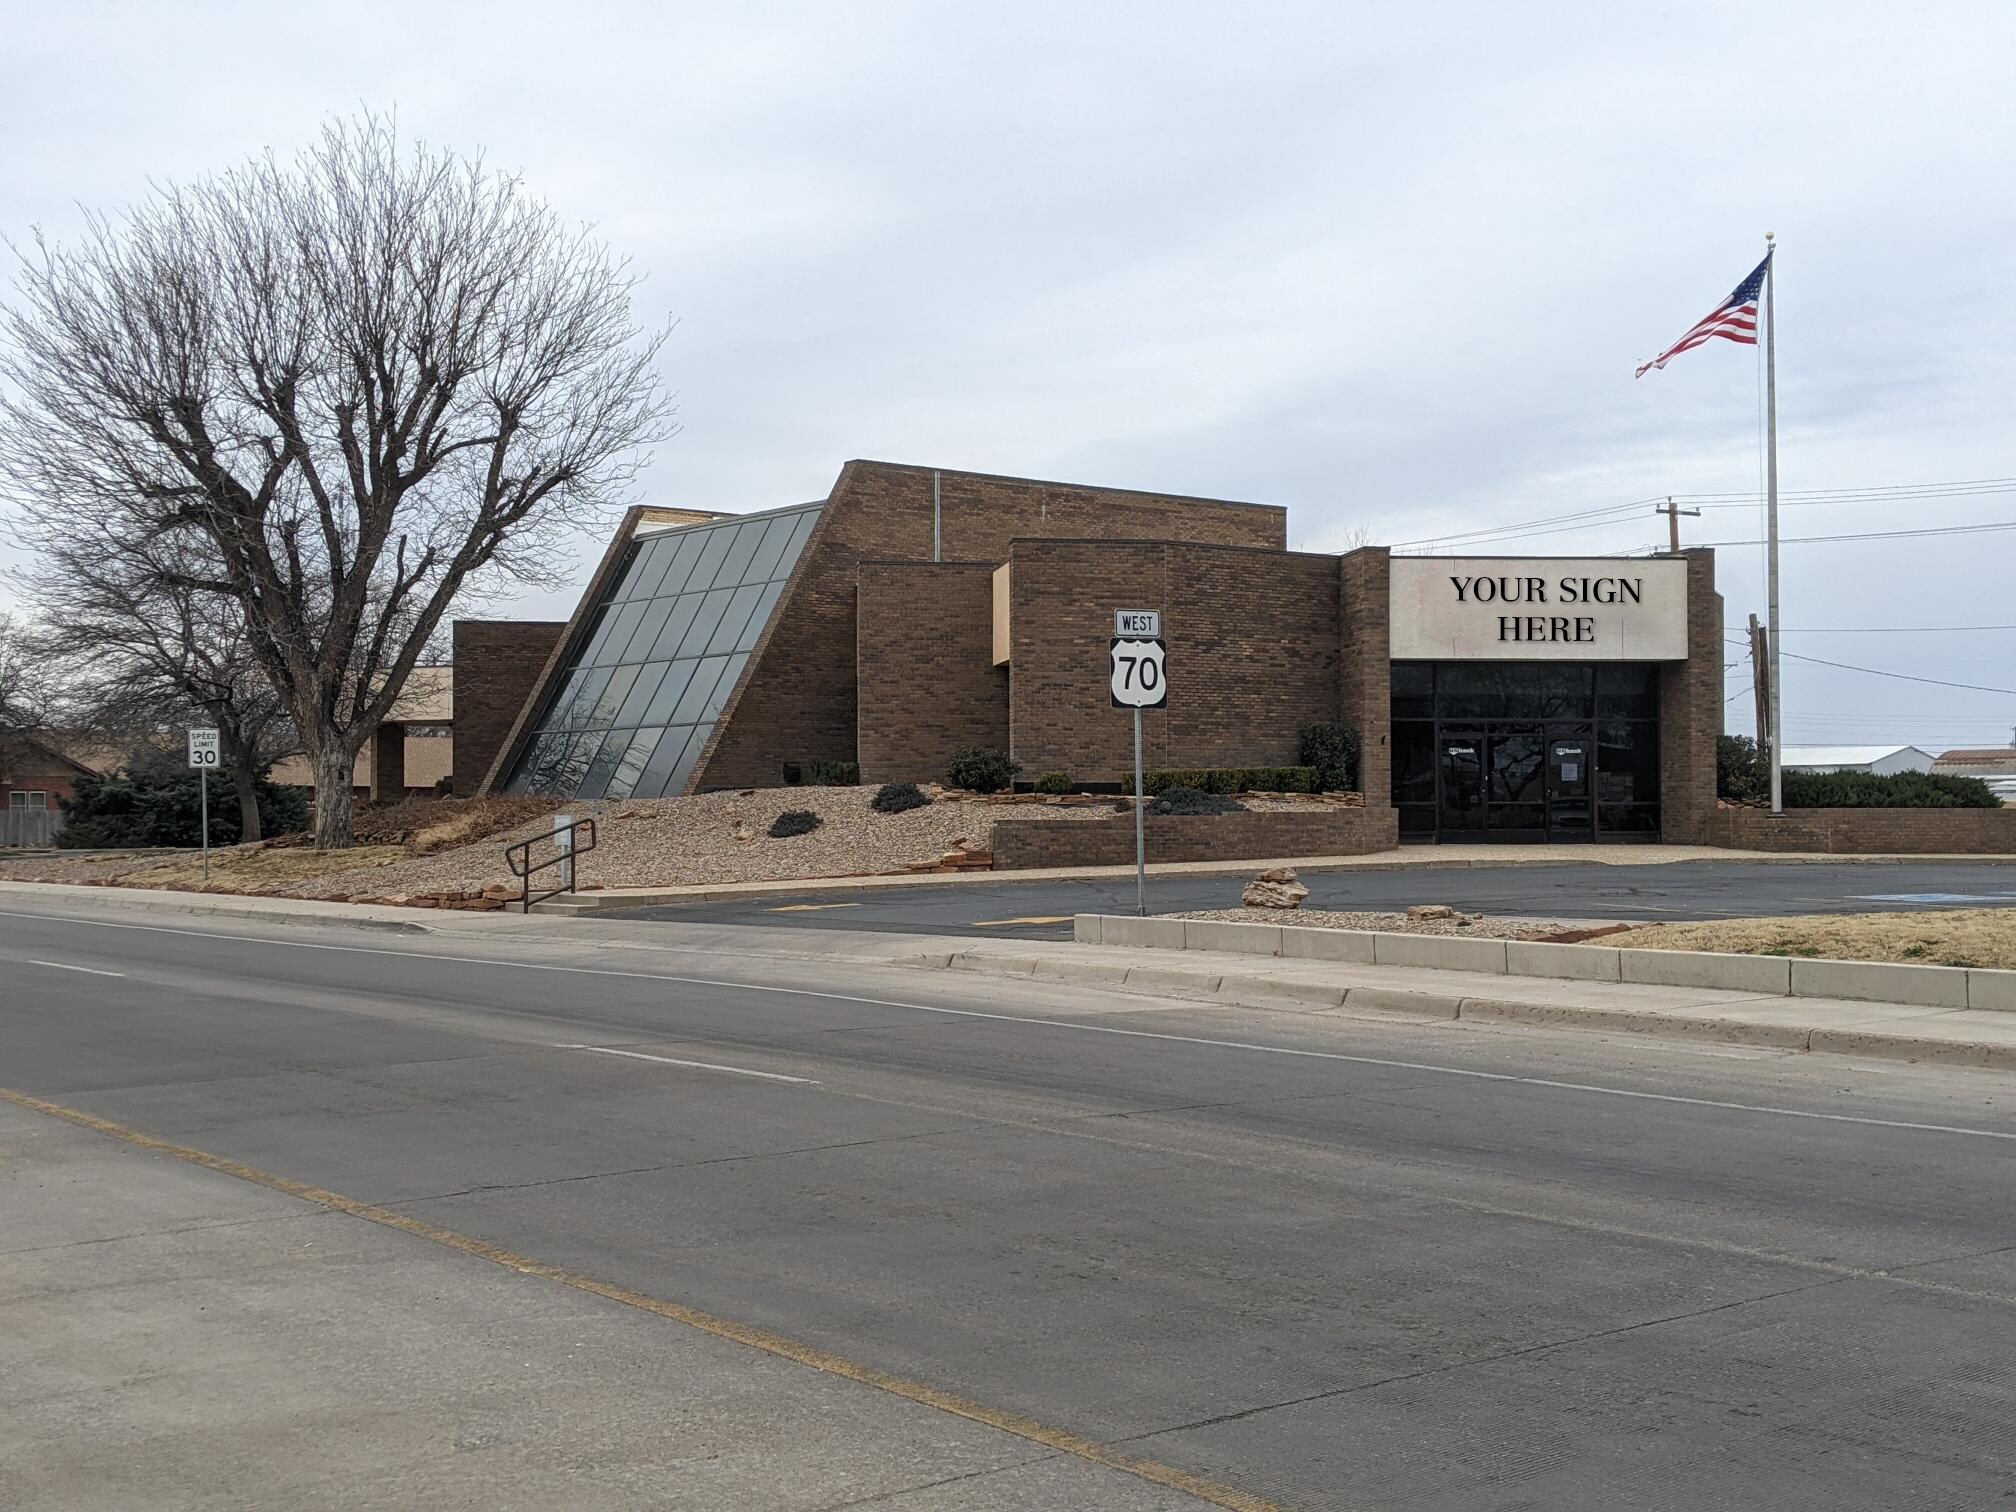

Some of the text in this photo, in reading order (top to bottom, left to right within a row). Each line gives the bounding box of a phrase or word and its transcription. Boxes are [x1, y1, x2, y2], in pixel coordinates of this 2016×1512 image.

[1449, 576, 1643, 603] YOUR SIGN
[1122, 615, 1153, 631] WEST
[1497, 616, 1595, 642] HERE
[1118, 656, 1158, 691] 70
[192, 750, 216, 764] 30
